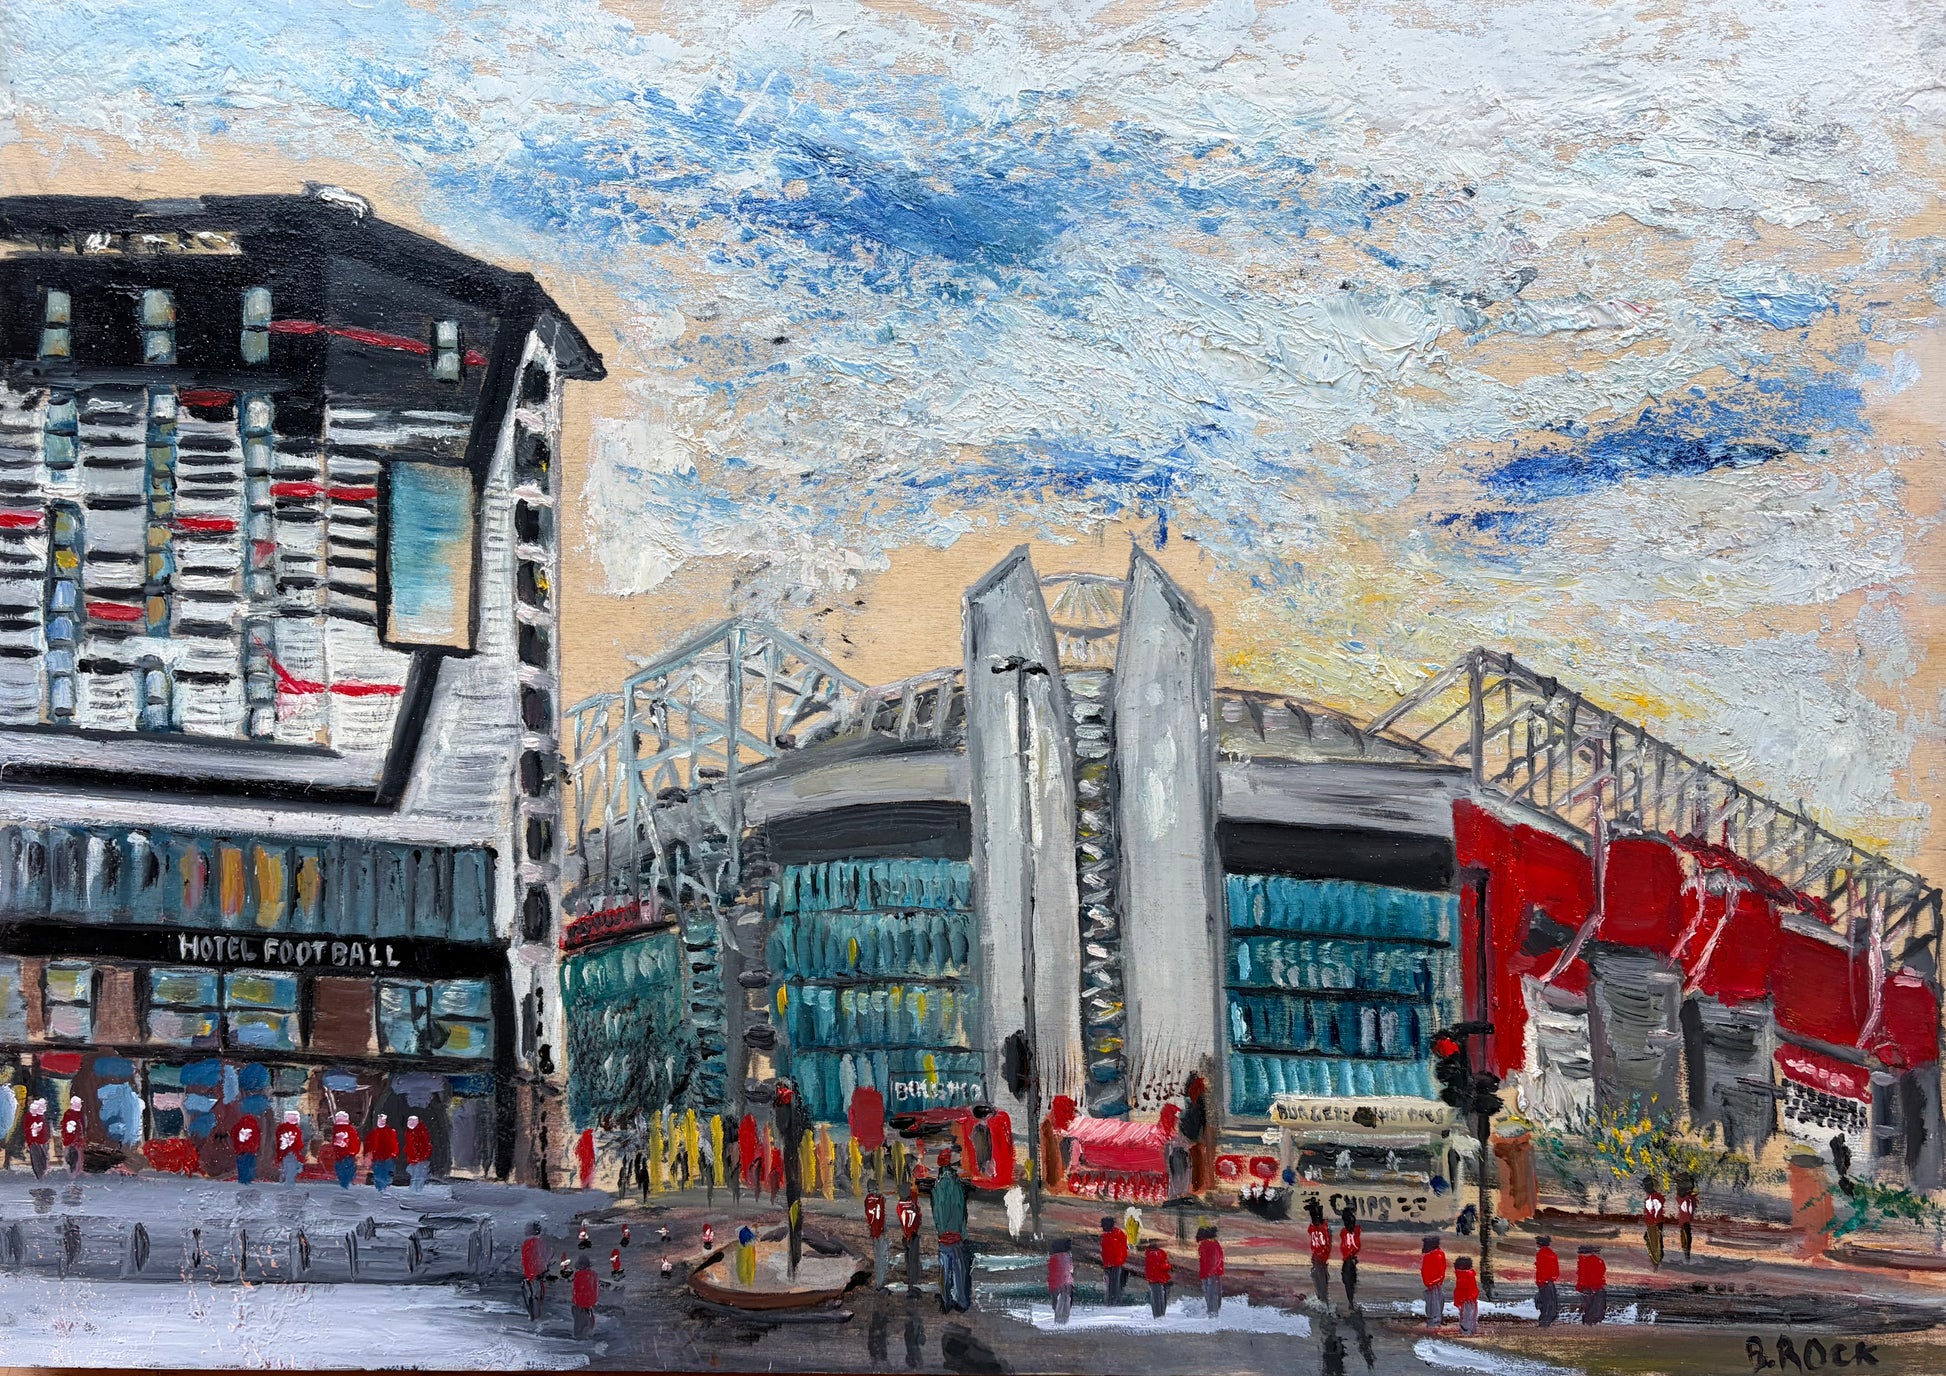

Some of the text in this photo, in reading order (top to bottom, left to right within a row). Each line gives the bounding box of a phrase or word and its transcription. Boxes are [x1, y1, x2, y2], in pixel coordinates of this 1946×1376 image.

[178, 932, 401, 968] HOTEL FOOTBALL
[1329, 1192, 1392, 1221] CHIPS
